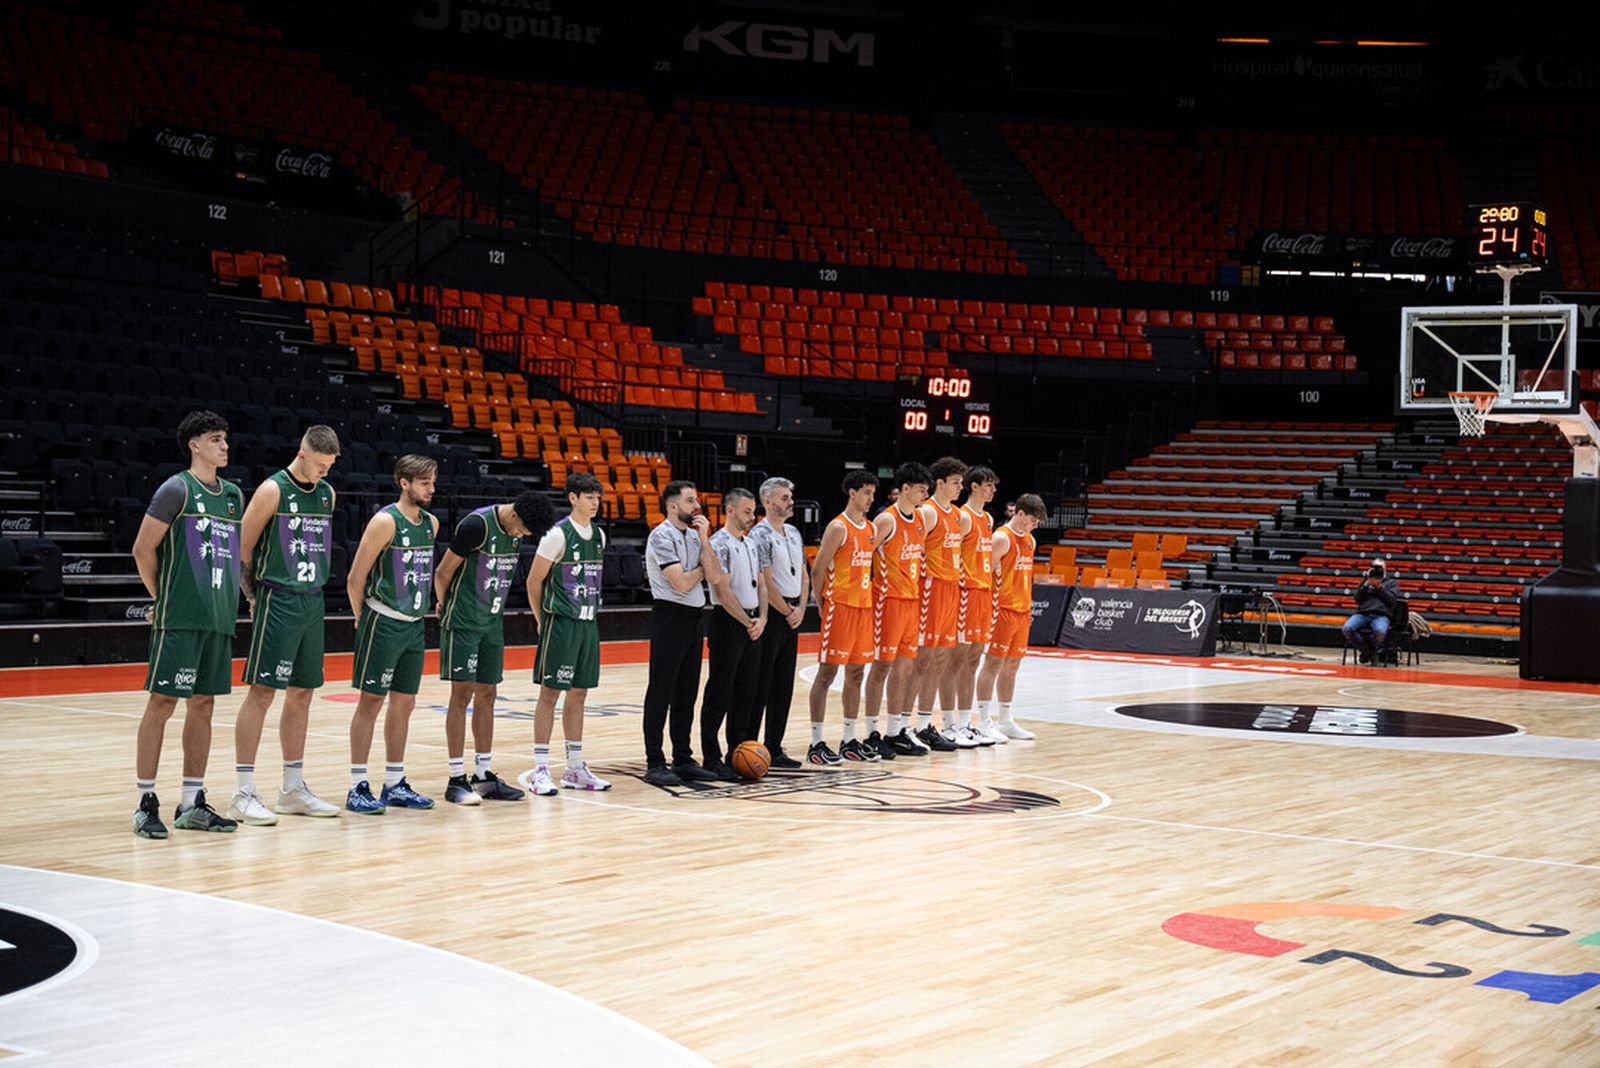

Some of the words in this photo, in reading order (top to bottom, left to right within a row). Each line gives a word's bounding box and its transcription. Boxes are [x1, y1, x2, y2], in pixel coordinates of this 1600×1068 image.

[458, 9, 602, 44] popular
[682, 20, 877, 67] KGM
[1535, 55, 1600, 88] Cai
[208, 203, 227, 220] 122
[1479, 227, 1519, 255] 24
[488, 249, 505, 265] 121
[818, 268, 838, 282] 120
[1209, 289, 1230, 303] 119
[928, 377, 971, 398] 10:00
[900, 398, 927, 409] LOCAL
[1299, 390, 1320, 404] 100
[904, 411, 928, 430] 00
[968, 414, 991, 434] 00
[297, 562, 316, 582] 23
[910, 563, 918, 579] 9
[983, 558, 991, 573] 6
[861, 573, 870, 589] 8
[413, 591, 422, 611] 9
[490, 597, 501, 614] 5
[1100, 599, 1133, 609] valencia
[1097, 609, 1125, 619] basket
[1094, 618, 1113, 627] club
